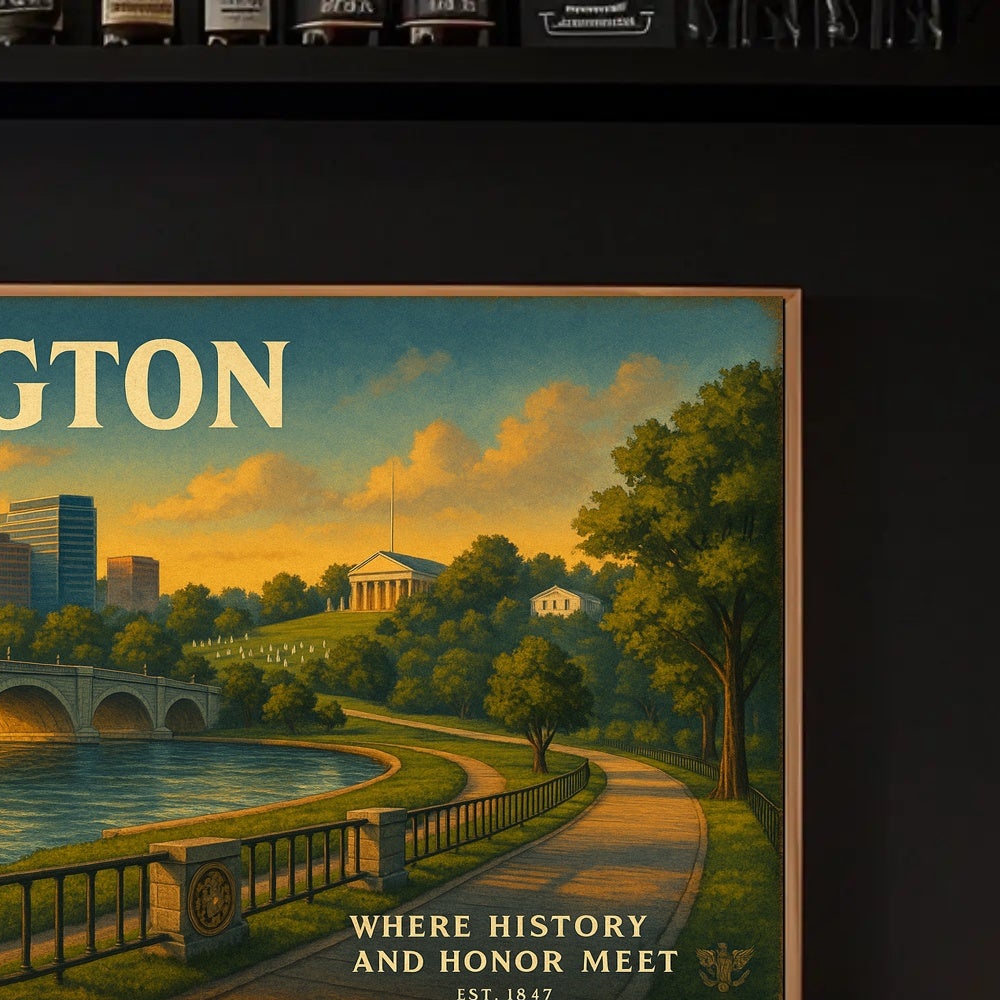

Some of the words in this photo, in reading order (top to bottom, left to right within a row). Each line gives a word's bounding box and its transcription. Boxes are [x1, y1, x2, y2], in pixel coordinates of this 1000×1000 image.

[349, 914, 471, 939] WHERE
[488, 914, 648, 939] HISTORY
[352, 950, 424, 973] AND
[439, 950, 564, 974] HONOR
[580, 950, 679, 973] MEET
